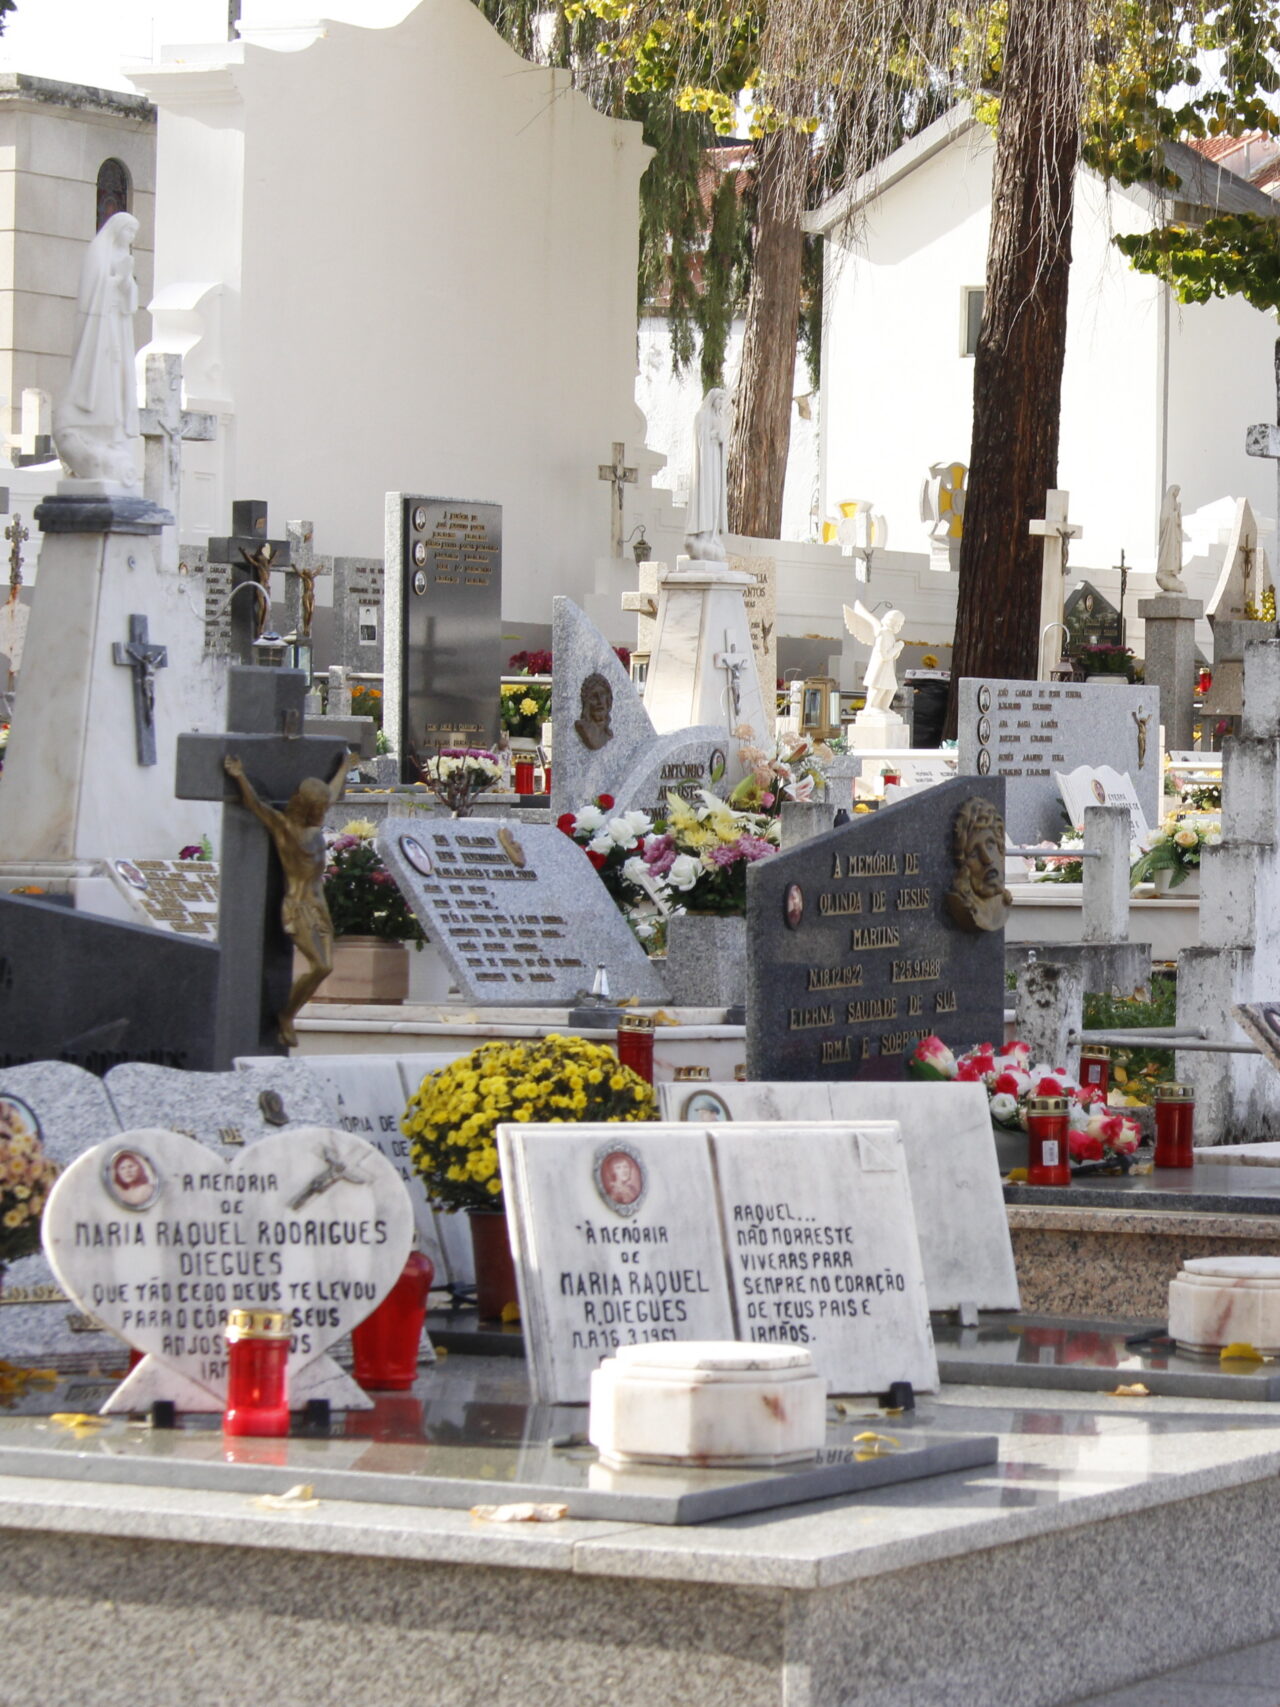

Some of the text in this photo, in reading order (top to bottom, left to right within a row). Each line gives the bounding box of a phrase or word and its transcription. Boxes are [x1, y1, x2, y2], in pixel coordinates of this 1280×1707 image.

[660, 761, 704, 779] ANTÓNIO
[849, 850, 898, 877] MEMÓRIA
[904, 852, 920, 875] DE
[819, 887, 930, 916] OLINDA DE JESUS
[853, 926, 900, 950] MARTINS
[790, 989, 958, 1030] ETERNA SAUDADE DE SUA
[380, 1115, 397, 1132] DE
[392, 1140, 409, 1157] DE
[221, 1200, 243, 1214] DE
[75, 1220, 388, 1249] MARIA RAQUEL RODRIGUES
[600, 1219, 669, 1244] MEMÓRIA
[737, 1224, 854, 1246] NÃO MORRESTE
[180, 1252, 283, 1275] DIEGUES
[621, 1251, 640, 1264] DE
[741, 1251, 854, 1270] VIVERAS PARA
[92, 1276, 377, 1306] QUE TÃO CEDO DEUS TE LEVOU
[561, 1270, 709, 1298] MARIA RAQUEL
[743, 1268, 905, 1295] SEMPRE NO CORAÇÃO
[122, 1309, 172, 1330] PARA
[177, 1309, 187, 1329] O
[193, 1305, 228, 1329] CÓR
[291, 1307, 341, 1328] SEUS
[585, 1300, 687, 1326] R.DIEGUES
[747, 1299, 871, 1319] DE TEUS PAIS E
[751, 1321, 817, 1343] IRMÃOS.
